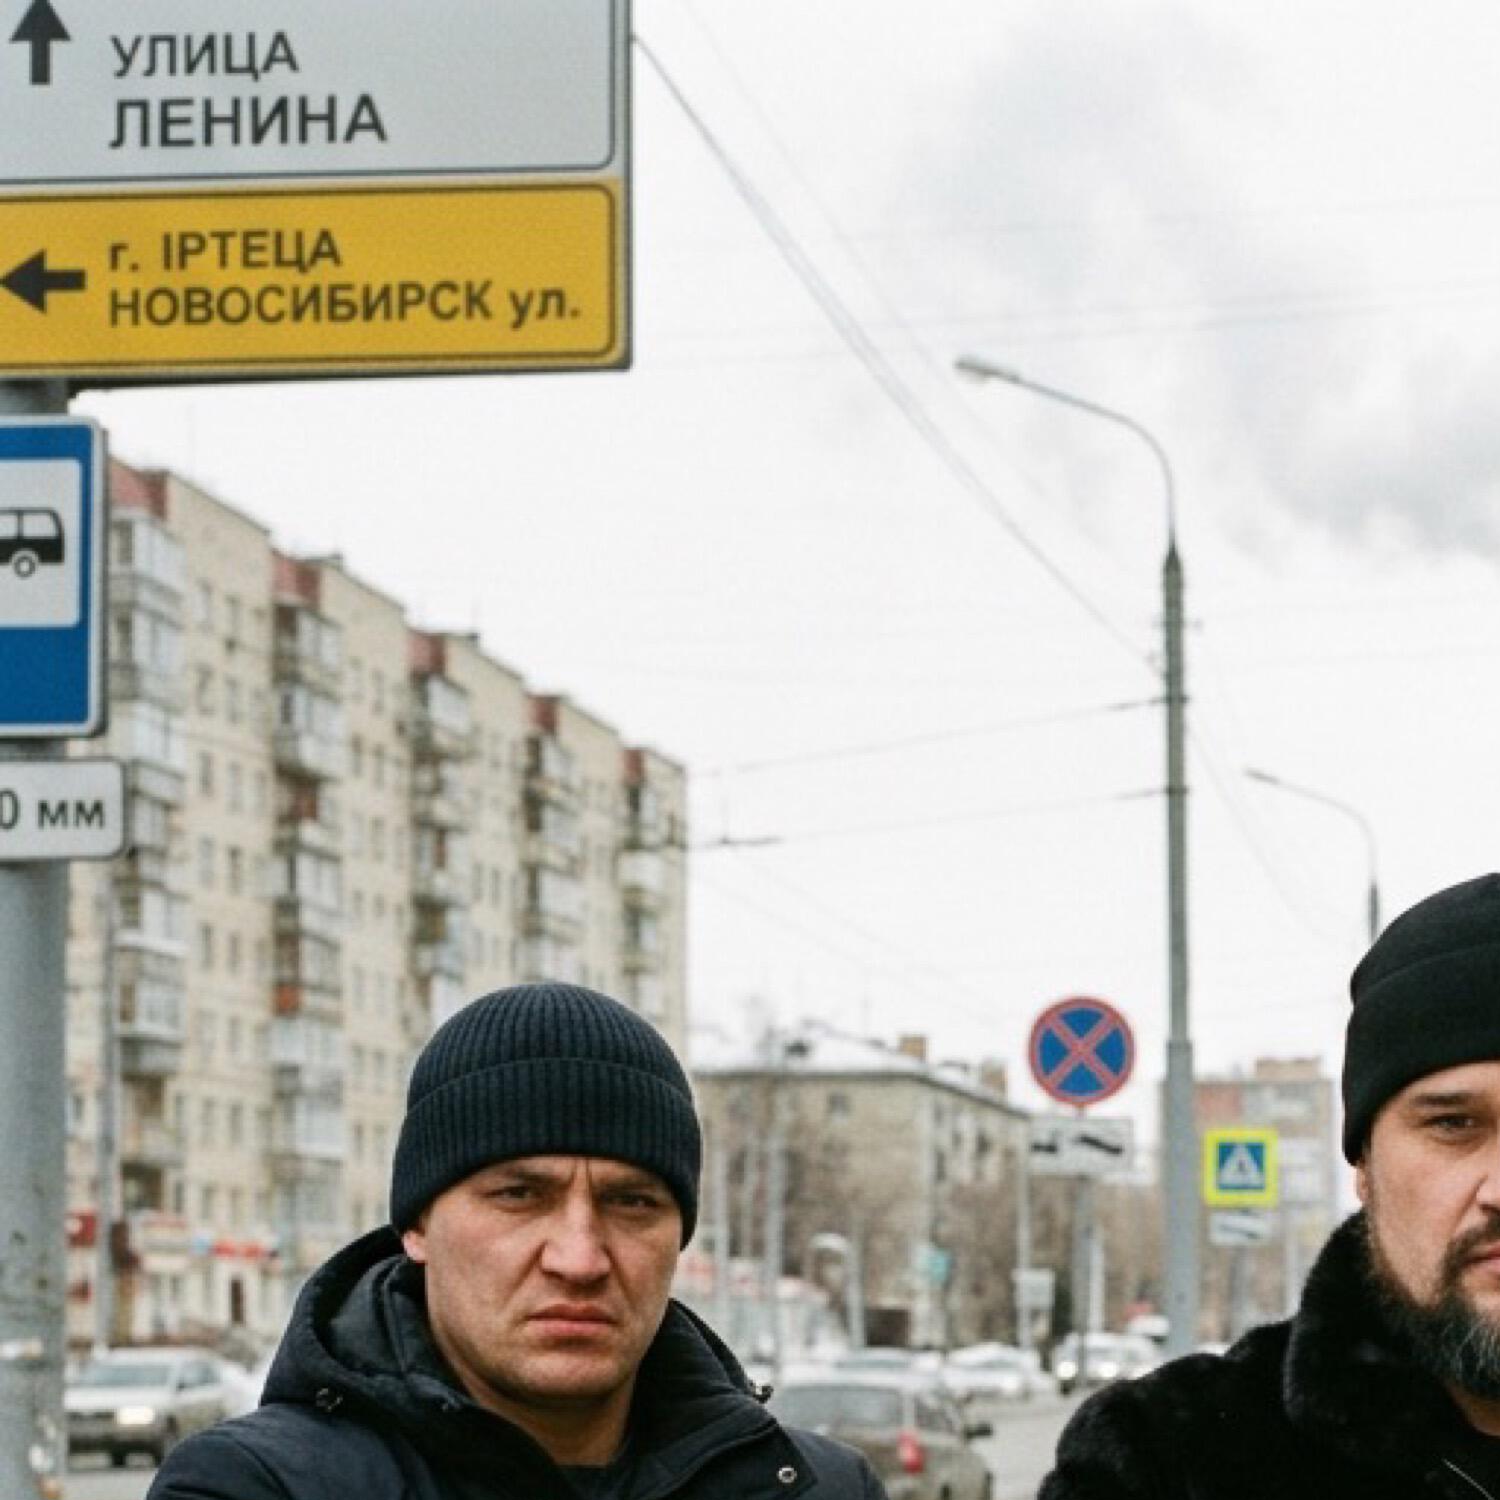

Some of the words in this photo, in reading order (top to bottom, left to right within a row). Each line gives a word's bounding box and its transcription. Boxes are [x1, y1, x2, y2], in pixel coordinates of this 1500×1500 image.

[109, 29, 300, 82] УЛИЦА
[107, 92, 388, 149] ЛЕНИНА
[109, 241, 140, 272] г.
[109, 279, 494, 328] НОВОСИБИРСК
[508, 286, 582, 331] ул.
